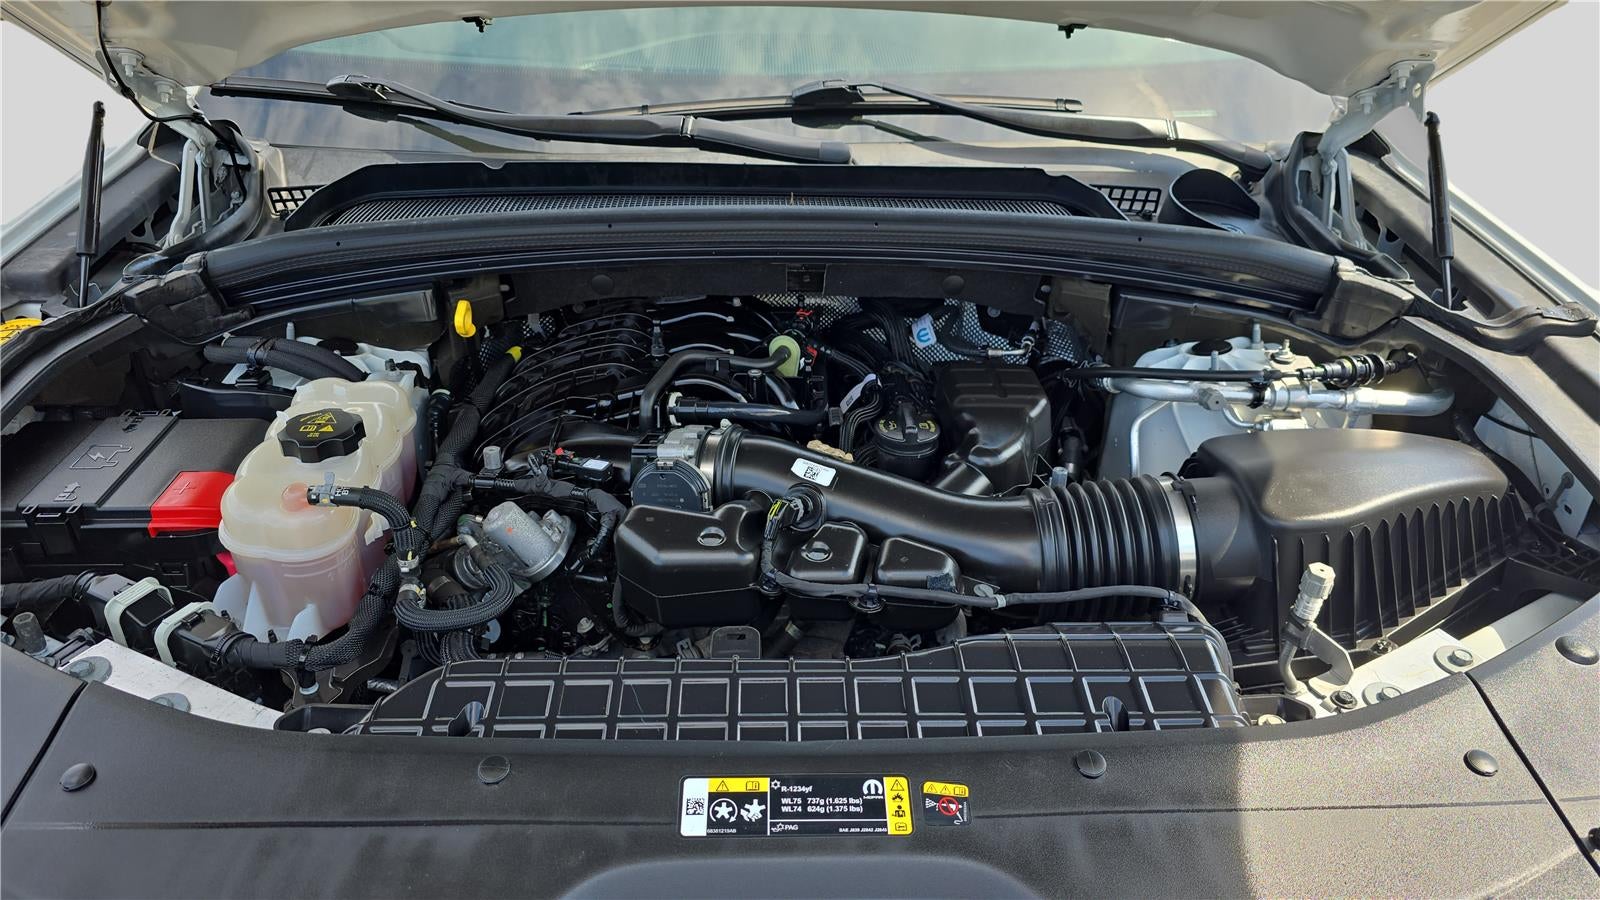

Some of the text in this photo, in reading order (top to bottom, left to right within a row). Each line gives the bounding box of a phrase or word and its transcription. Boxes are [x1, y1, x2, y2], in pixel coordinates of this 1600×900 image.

[781, 785, 813, 793] R-1234yf
[807, 797, 825, 805] 737g
[826, 797, 848, 805] (1.625
[849, 797, 863, 805] lbs)
[807, 805, 825, 813] 624g
[826, 805, 848, 813] (1.375
[849, 805, 863, 813] lbs)
